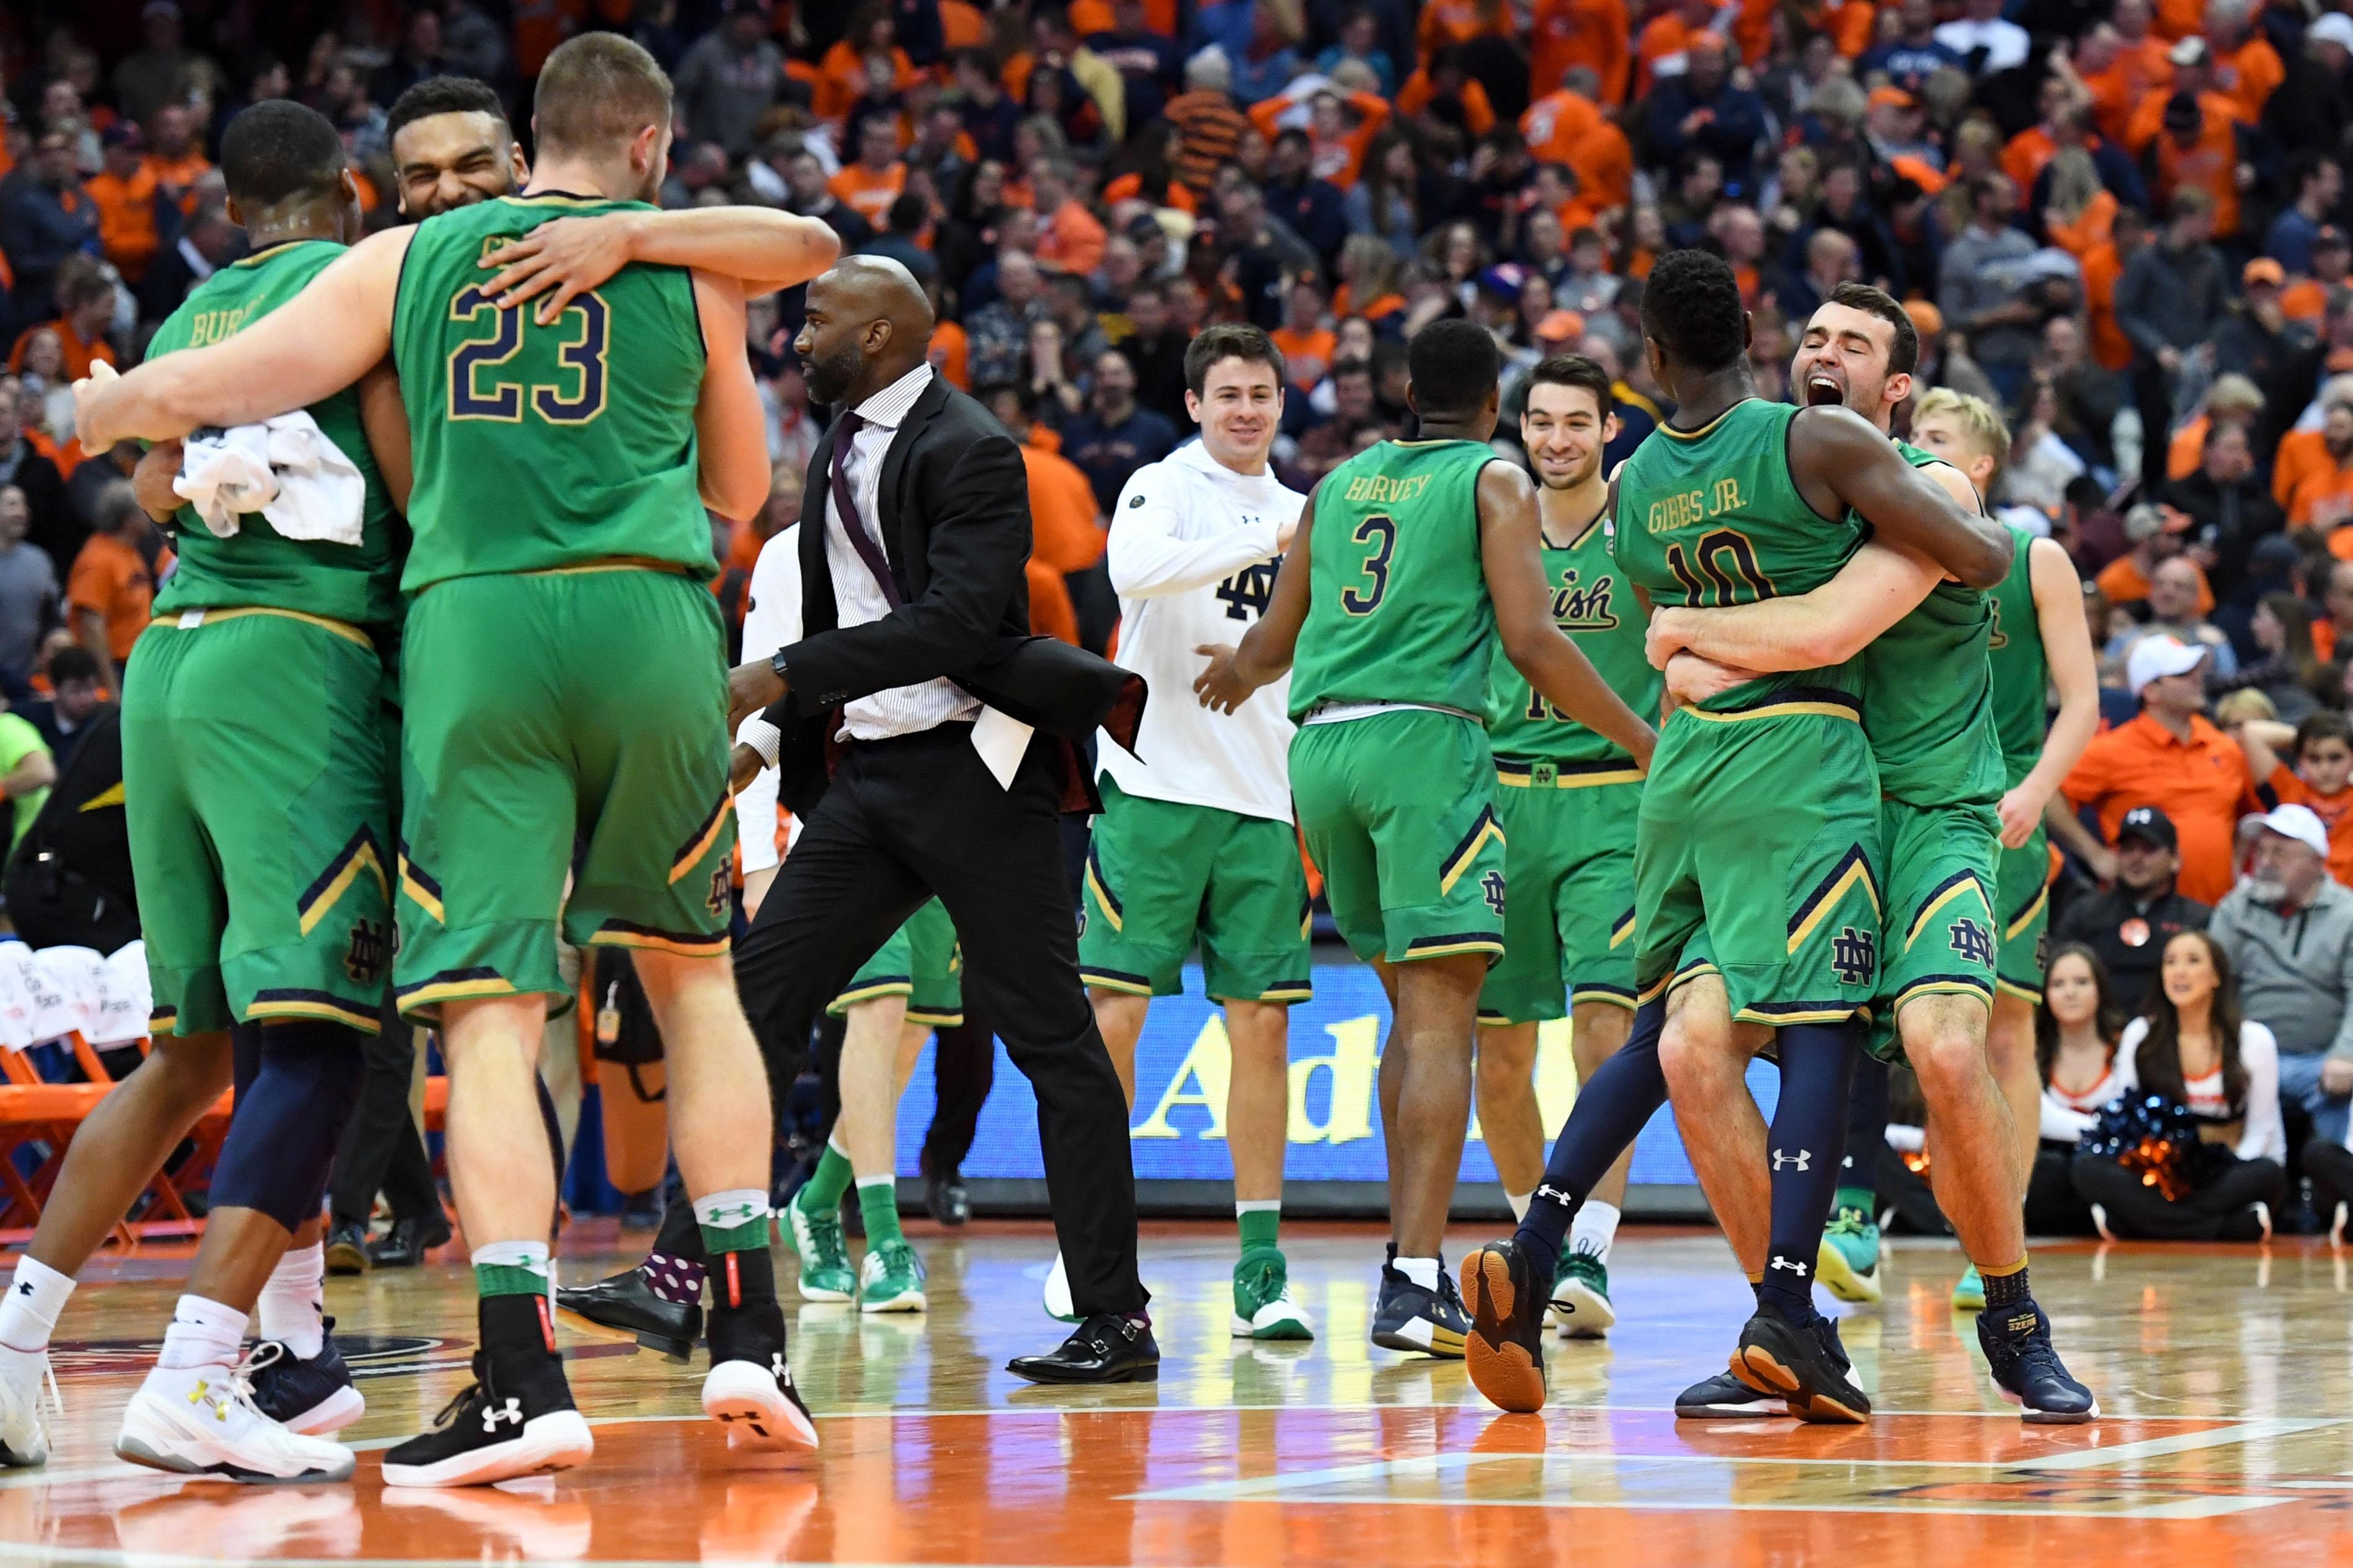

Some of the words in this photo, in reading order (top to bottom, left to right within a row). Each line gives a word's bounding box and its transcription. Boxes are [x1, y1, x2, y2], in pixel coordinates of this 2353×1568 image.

[447, 281, 610, 424] 23
[1344, 474, 1432, 503] HARVEY
[1648, 490, 1704, 533] GIBBS
[1709, 477, 1747, 516] JR.
[1340, 513, 1396, 616] 3
[1550, 568, 1619, 631] ish
[1666, 527, 1779, 607] 10
